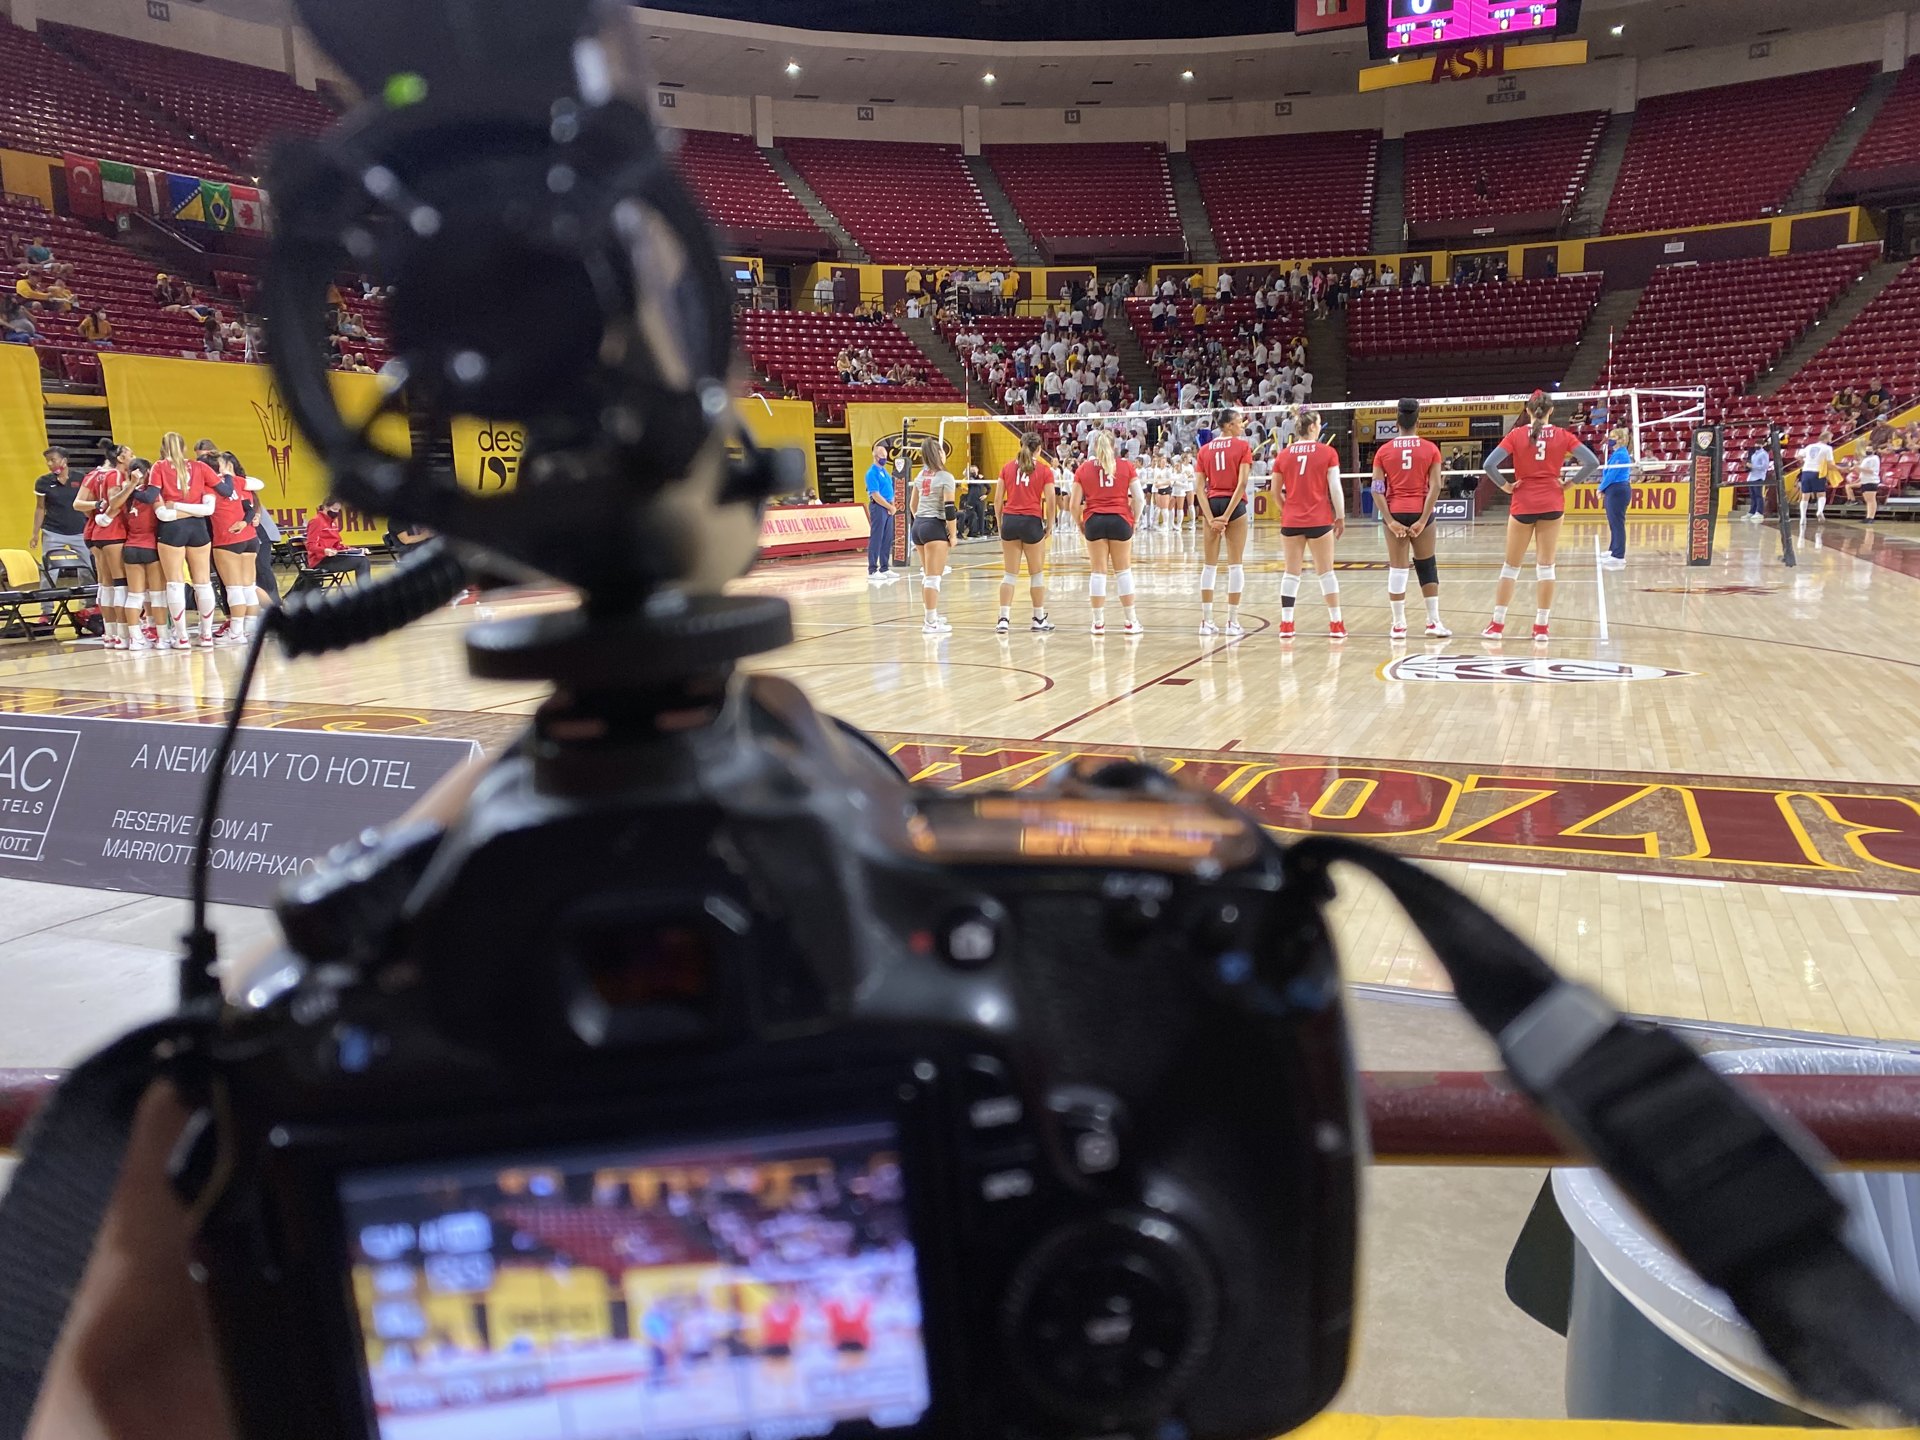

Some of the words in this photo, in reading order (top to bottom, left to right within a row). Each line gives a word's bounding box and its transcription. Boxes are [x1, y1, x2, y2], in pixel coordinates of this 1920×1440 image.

[1493, 8, 1515, 19] SETS
[1529, 4, 1546, 13] TOL
[1395, 22, 1416, 32] SETS
[1430, 19, 1446, 28] TOL
[1431, 43, 1505, 84] ASU
[1446, 404, 1463, 412] WHO
[1464, 403, 1488, 412] ENTER
[1490, 402, 1509, 410] HERE
[478, 419, 528, 452] des
[1393, 439, 1421, 448] REBELS
[1527, 429, 1554, 438] RELS
[1208, 440, 1232, 450] REBELS
[1289, 444, 1316, 453] REBELS
[1535, 440, 1546, 460] 3
[1215, 451, 1226, 471] 11
[1297, 455, 1308, 475] 7
[1402, 449, 1412, 470] 5
[1016, 468, 1030, 486] 14
[1098, 469, 1114, 487] 13
[1693, 456, 1712, 515] ARIZONA
[894, 477, 906, 512] STATE
[1574, 487, 1677, 510] INRNO
[316, 507, 377, 534] ORK
[775, 518, 801, 533] DEVIL
[801, 516, 850, 532] VOLLEYBALL
[1692, 518, 1709, 561] STATE
[0, 746, 58, 792] AC
[131, 743, 148, 769] A
[155, 744, 217, 773] NEW
[223, 749, 280, 778] WAY
[285, 753, 320, 782] TO
[325, 756, 416, 789] HOTEL
[111, 809, 195, 835] RESERVE
[195, 817, 245, 840] OW
[244, 821, 273, 843] AT
[102, 837, 315, 878] MARRIOTT.OM/PHXA
